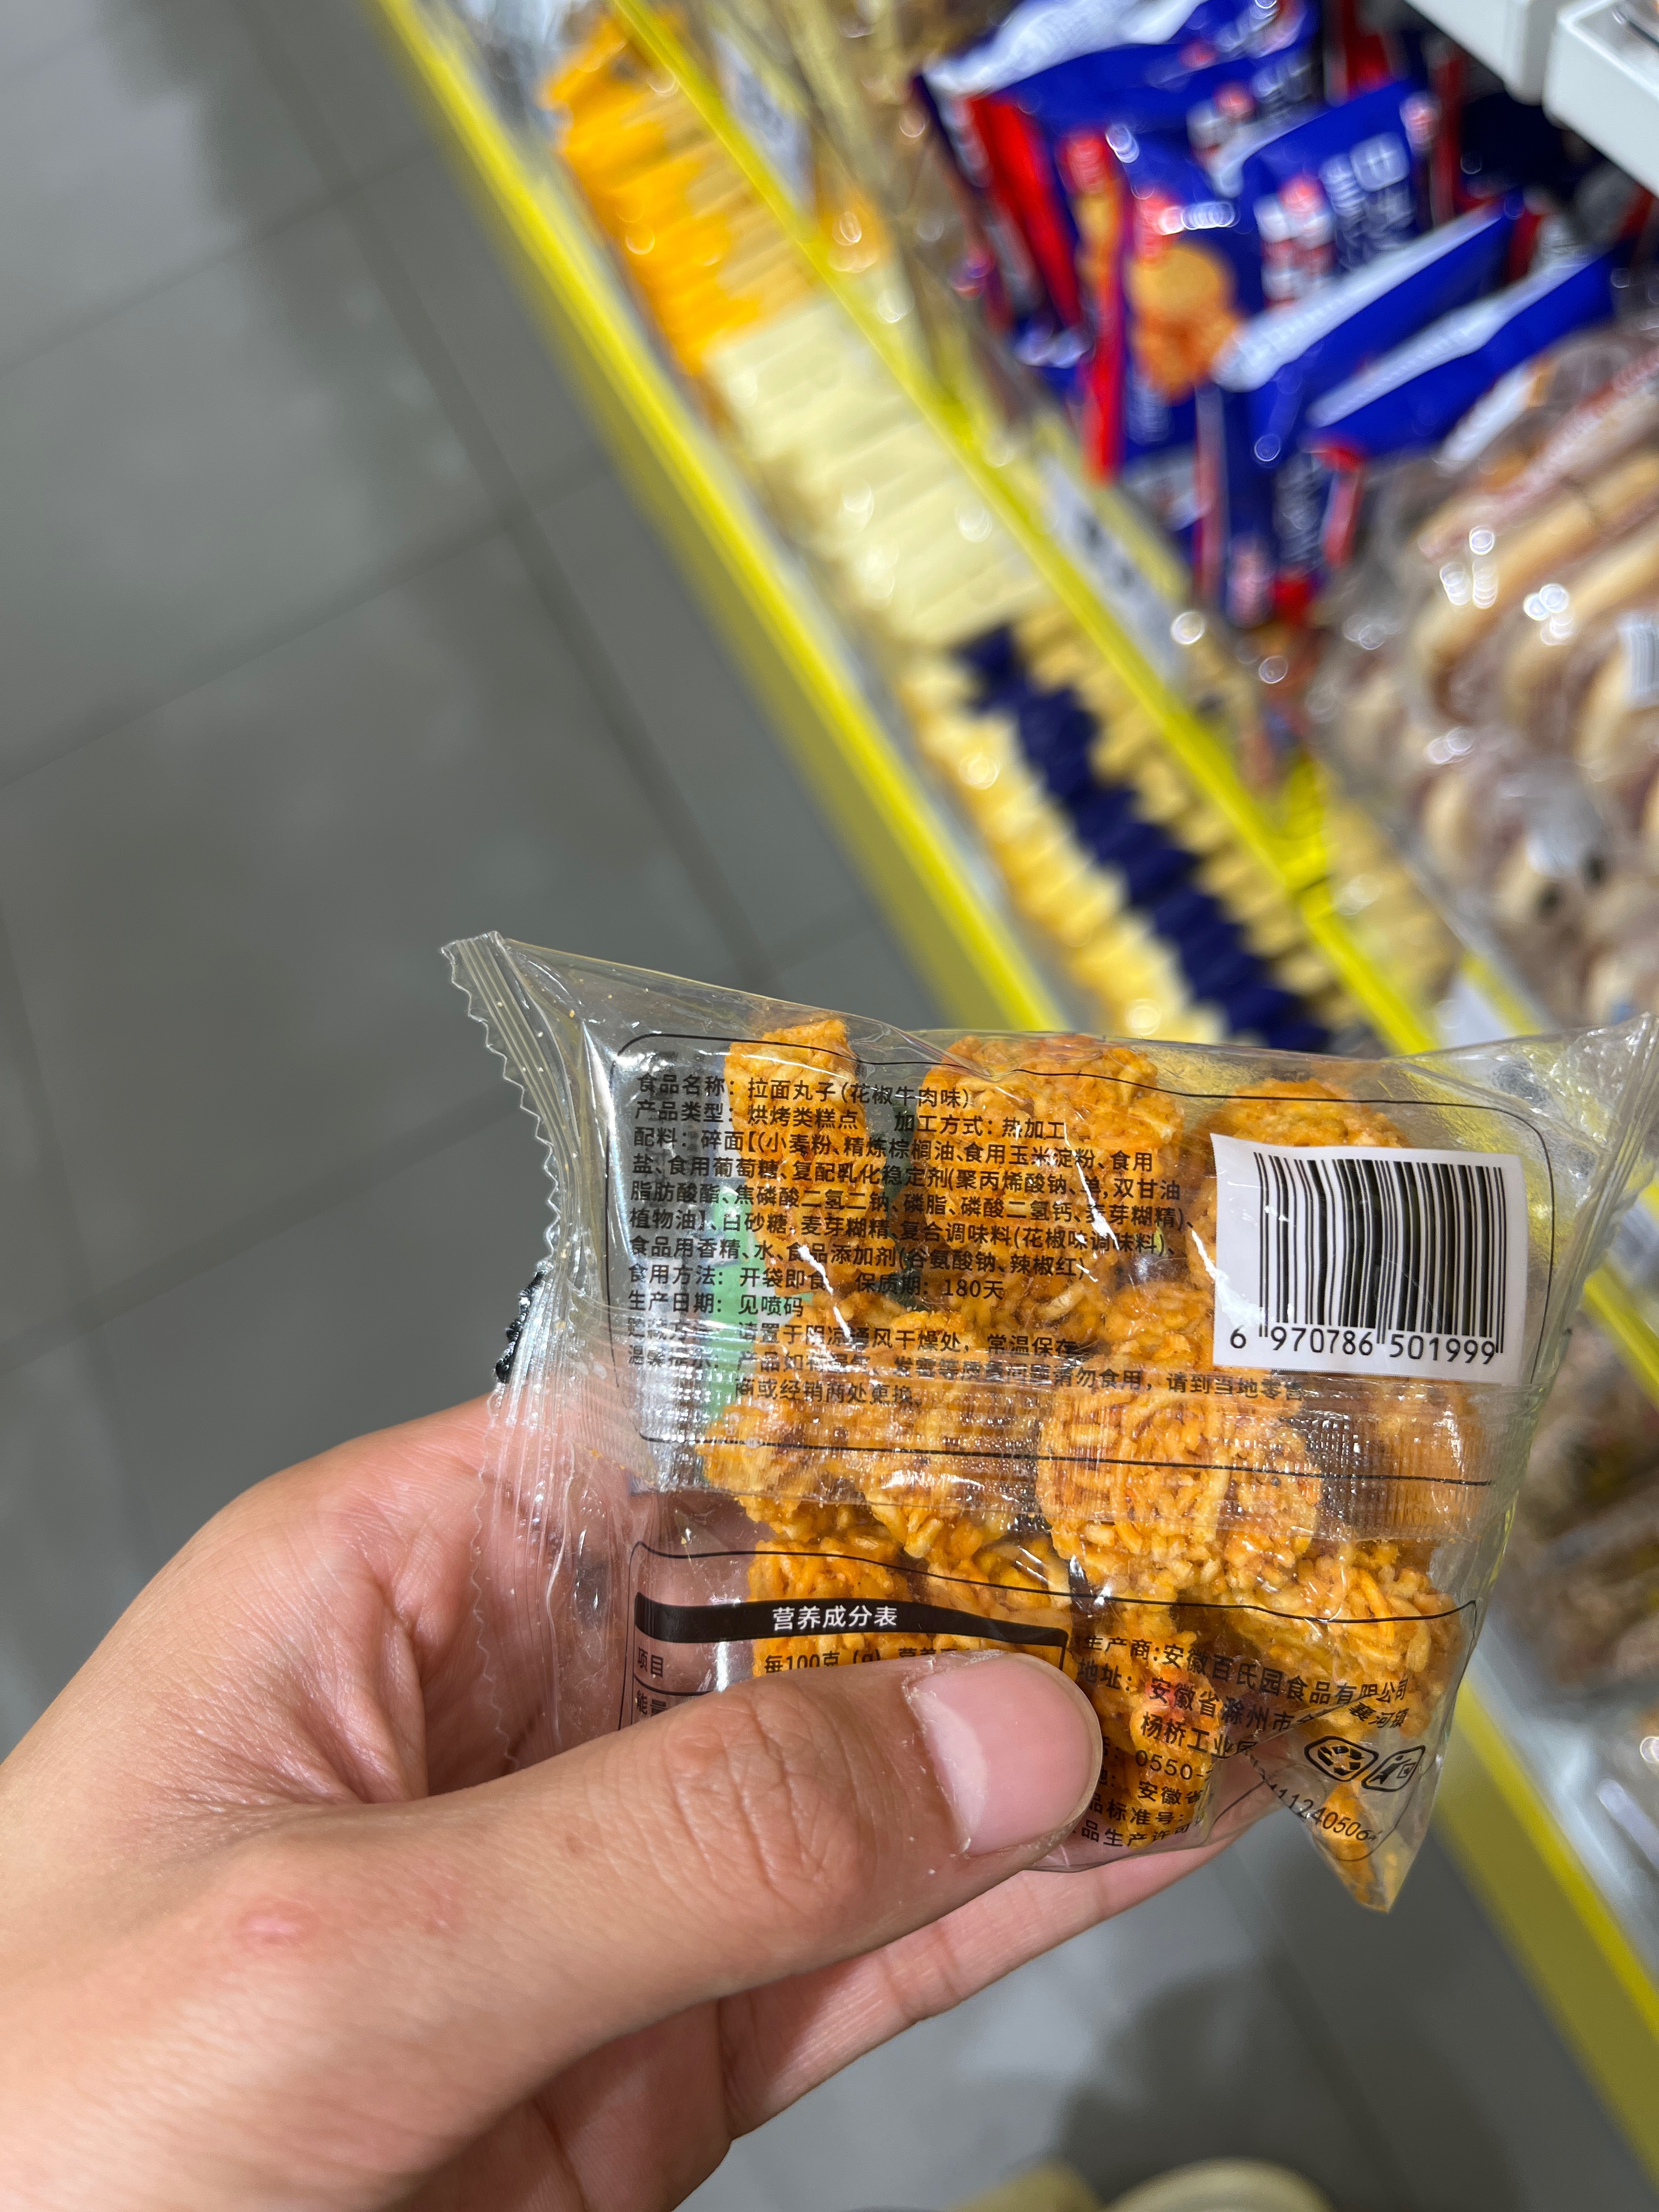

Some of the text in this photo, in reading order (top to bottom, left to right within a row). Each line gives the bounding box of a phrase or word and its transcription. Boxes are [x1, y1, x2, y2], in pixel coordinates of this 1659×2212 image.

[635, 1099, 1066, 1139] 产品类型：烘烤类糕点 加工方式：热加工
[629, 1263, 1003, 1300] 食用方法：开袋即食 保质期：180天
[628, 1291, 803, 1317] 生产日期：见喷码
[1229, 1325, 1496, 1365] 6 970786 501999
[772, 1605, 899, 1630] 营养成分表
[637, 1647, 664, 1678] 项目
